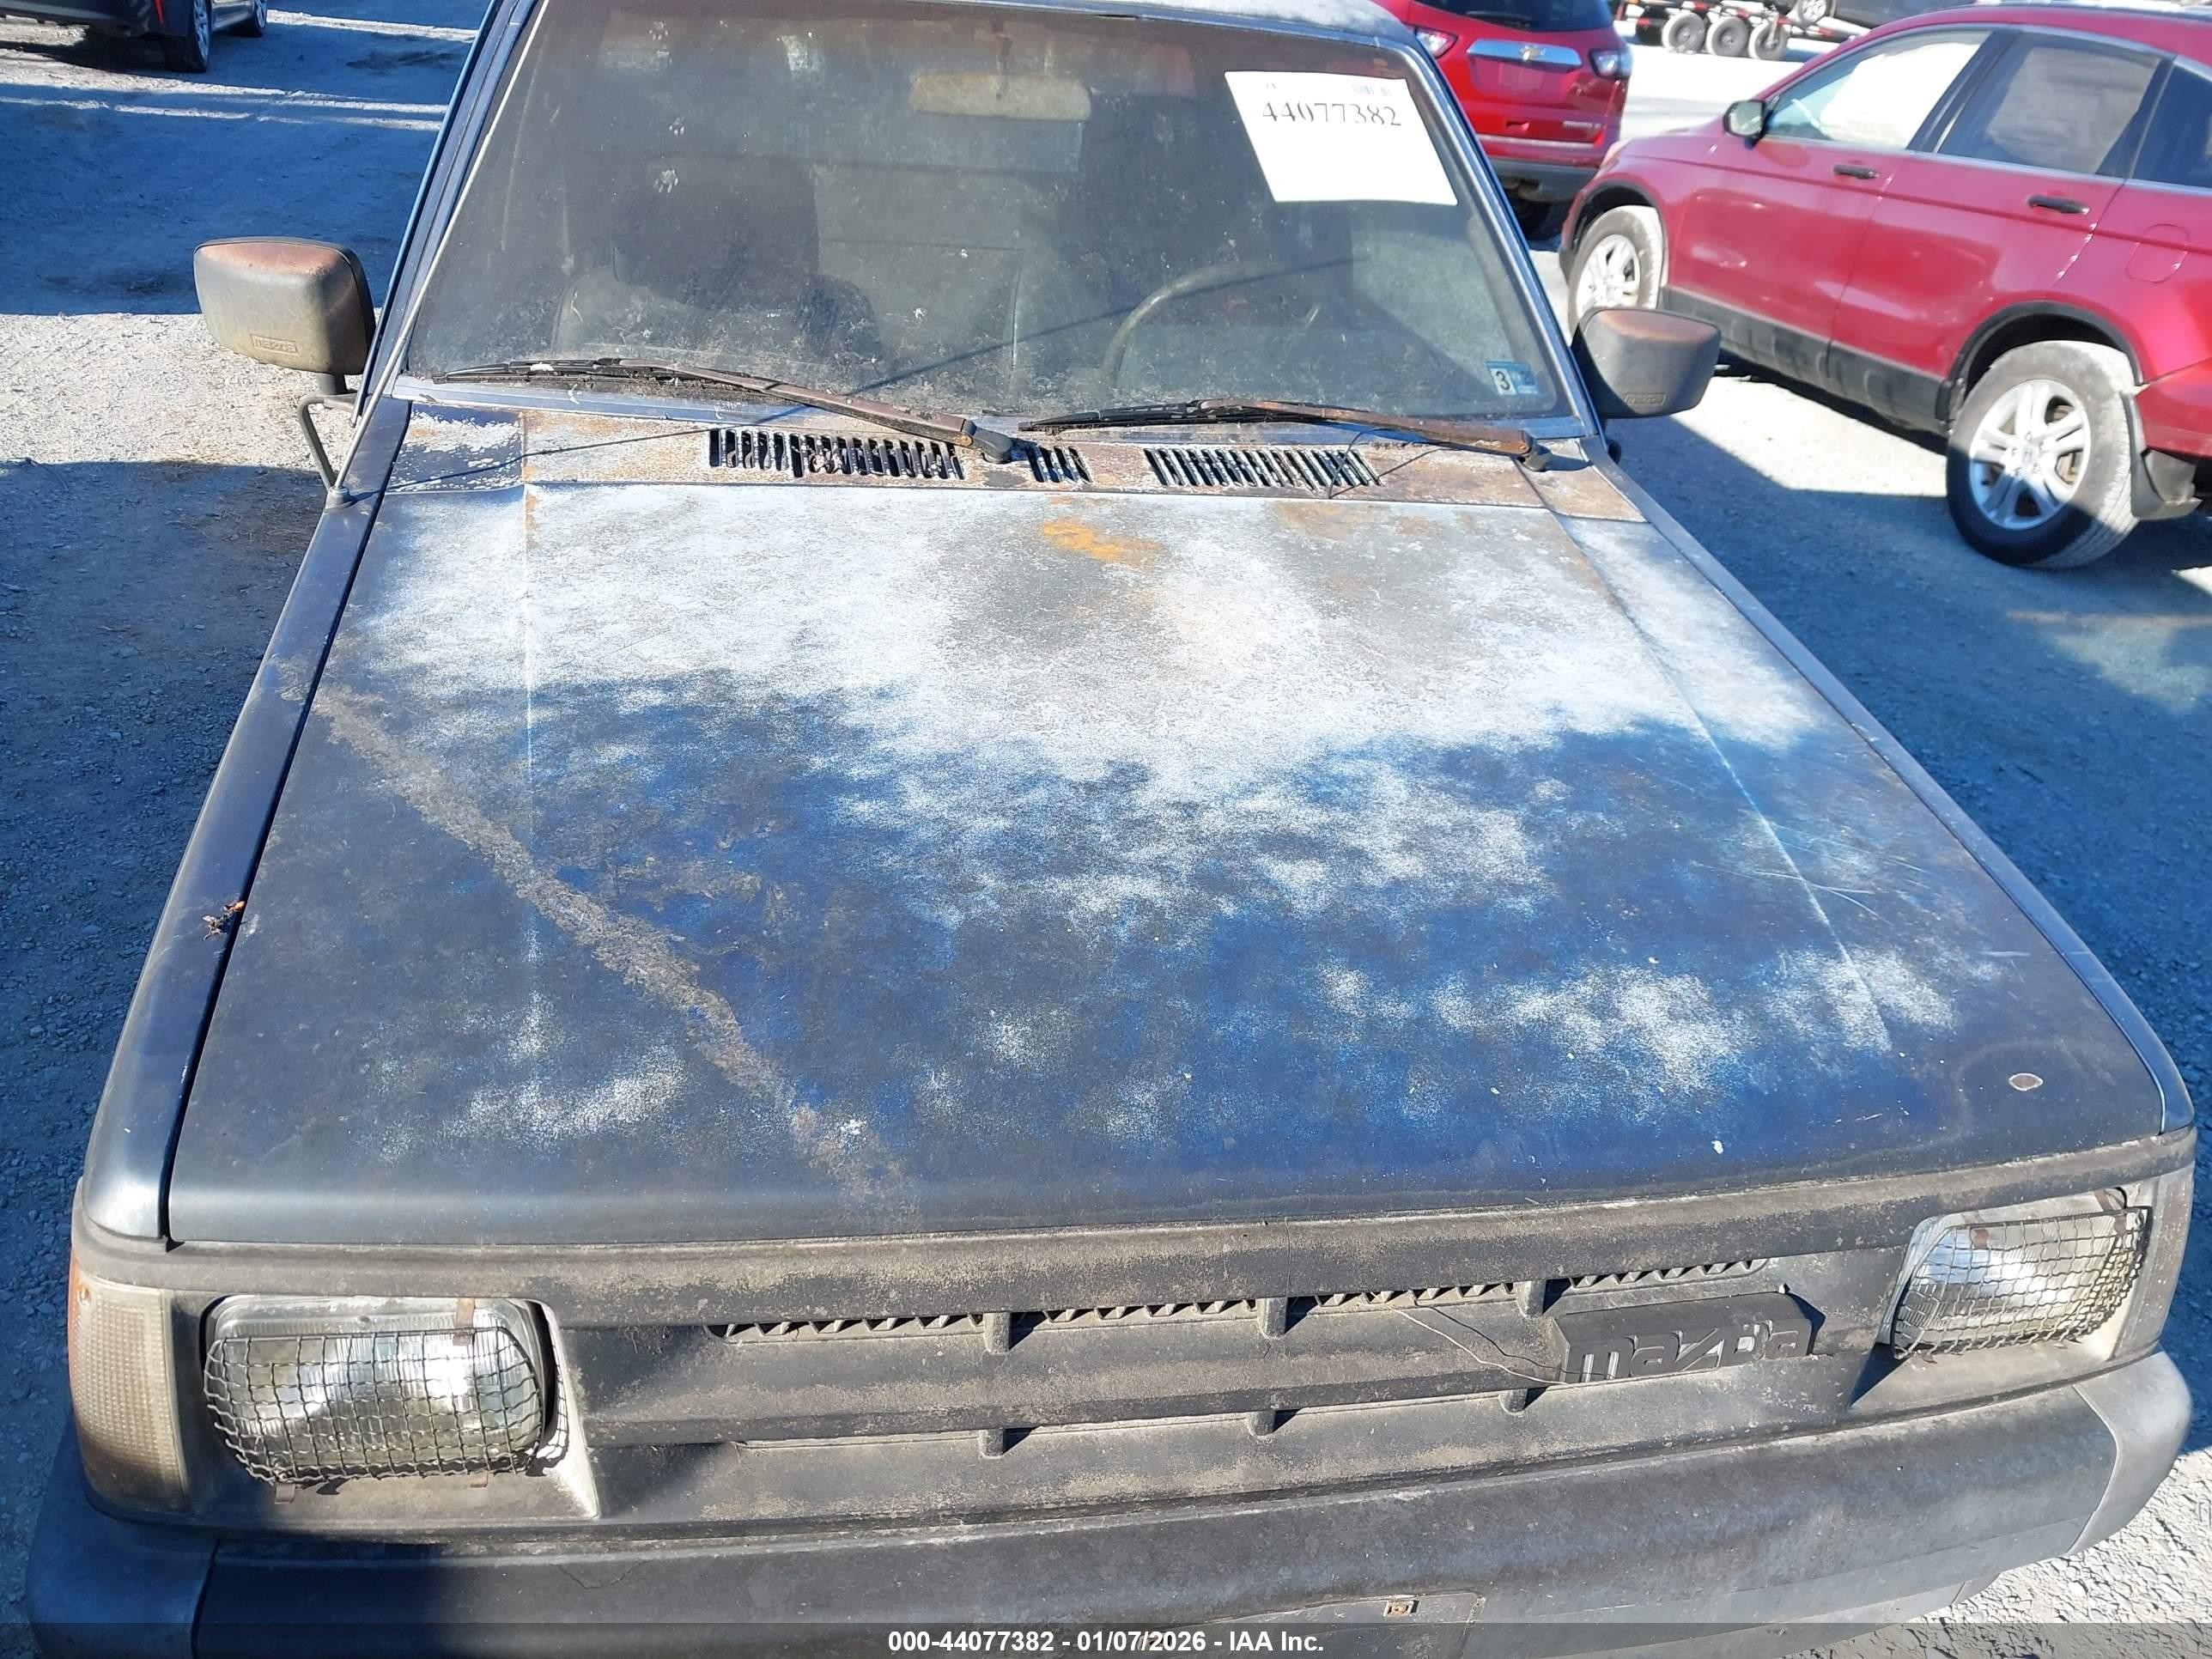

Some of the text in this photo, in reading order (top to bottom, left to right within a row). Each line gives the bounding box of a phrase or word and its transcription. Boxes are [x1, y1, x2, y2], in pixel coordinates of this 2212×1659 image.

[1262, 101, 1401, 126] 44077382
[1496, 370, 1510, 391] 3
[1561, 1320, 1811, 1383] mazda
